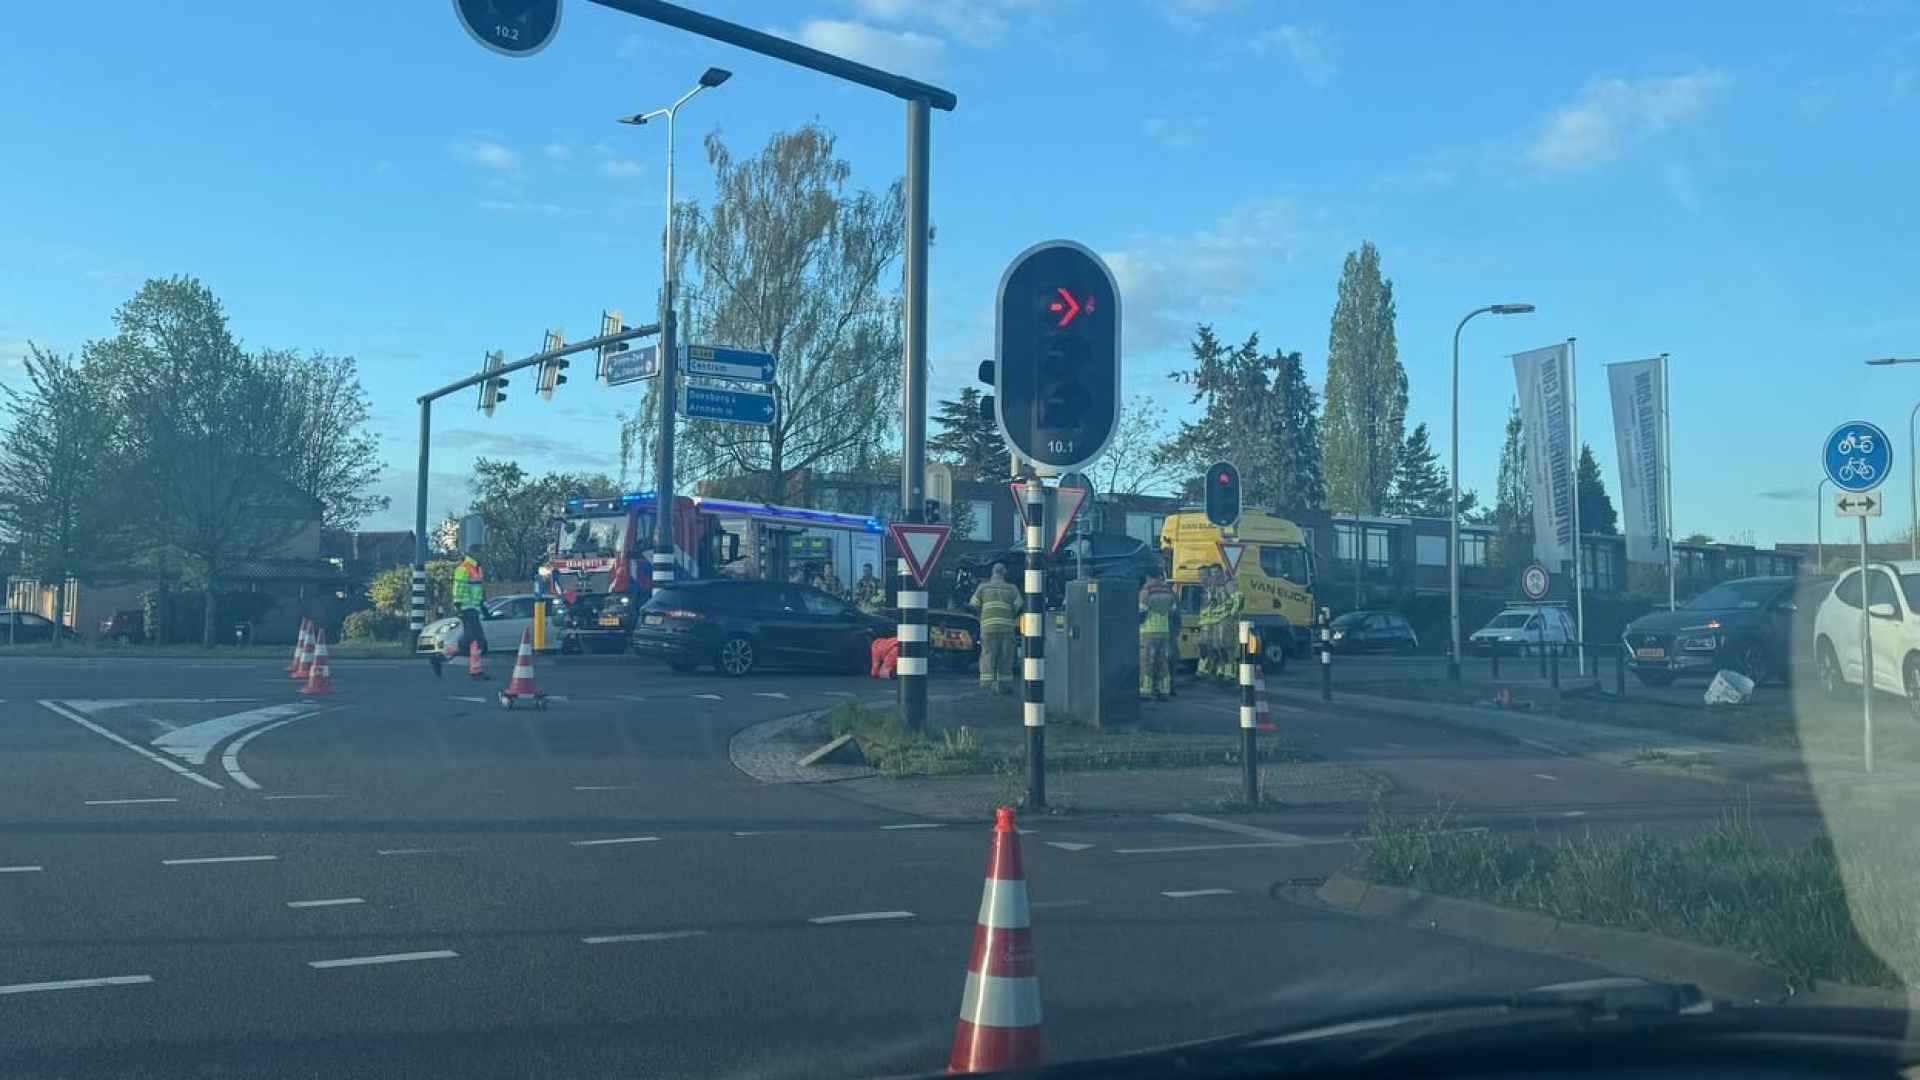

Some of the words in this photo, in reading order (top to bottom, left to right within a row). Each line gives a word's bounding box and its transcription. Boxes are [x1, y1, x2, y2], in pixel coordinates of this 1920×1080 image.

[495, 26, 518, 41] 10.2
[691, 361, 727, 372] Centrum
[689, 390, 730, 403] Doesburg
[689, 403, 724, 414] Arnhem
[1048, 441, 1074, 453] 10.1
[1250, 579, 1274, 594] VAN
[1277, 587, 1308, 603] EIJCK
